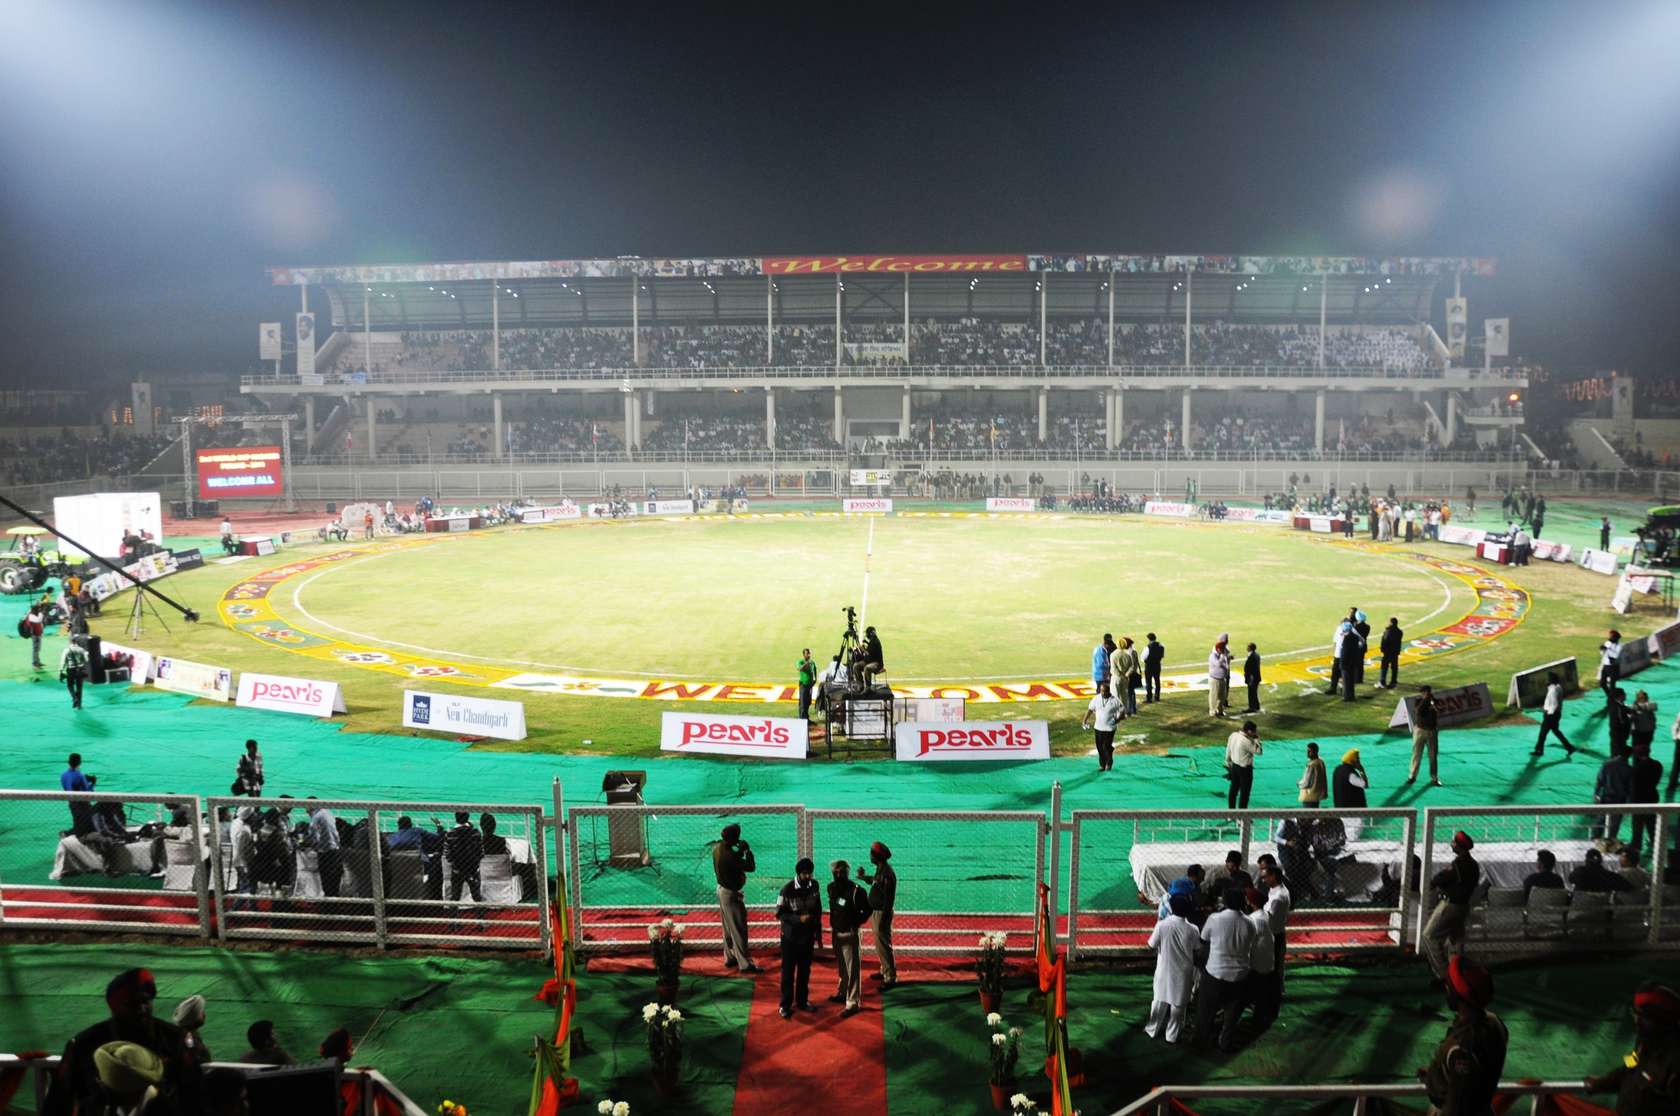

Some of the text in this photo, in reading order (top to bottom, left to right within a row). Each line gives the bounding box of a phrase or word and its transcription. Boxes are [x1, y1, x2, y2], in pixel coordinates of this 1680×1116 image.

[771, 256, 1024, 272] Welcome
[207, 475, 275, 487] WELCOME ALL
[250, 682, 322, 703] pearls
[446, 705, 460, 721] New
[677, 720, 789, 748] pearls
[915, 724, 1032, 757] pearls
